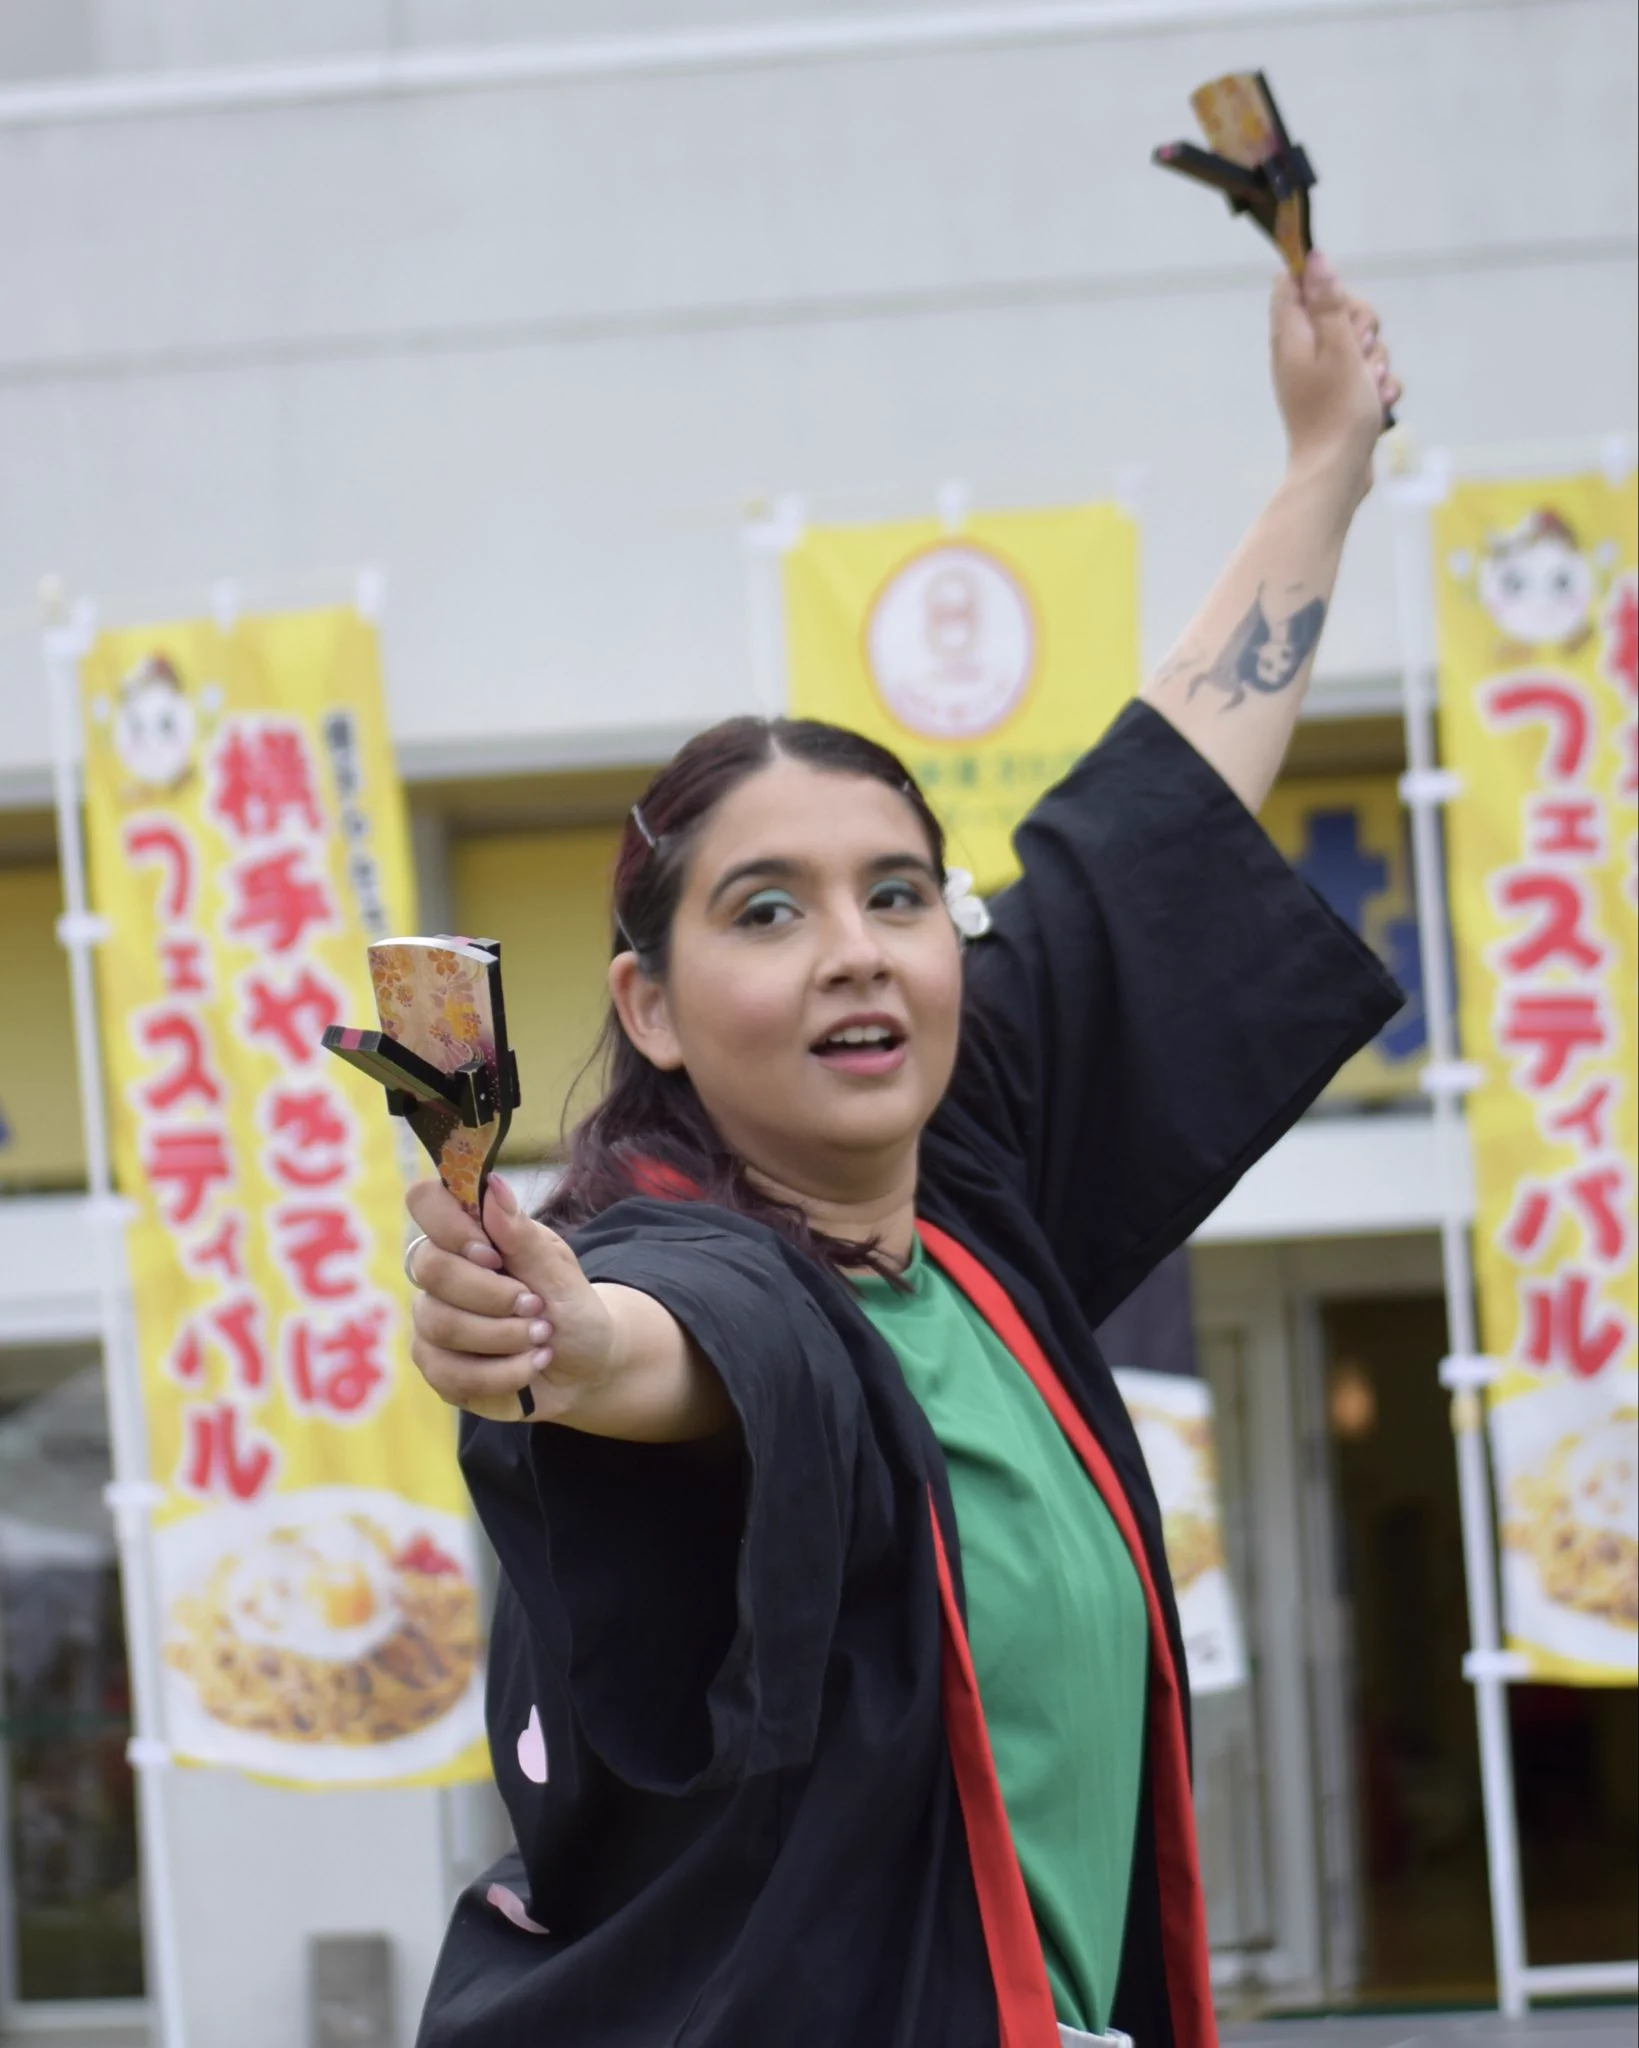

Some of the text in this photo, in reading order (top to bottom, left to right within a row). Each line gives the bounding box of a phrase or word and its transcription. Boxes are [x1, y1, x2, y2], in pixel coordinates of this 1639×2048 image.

[126, 824, 272, 1501] フェスティバル
[211, 724, 383, 1411] 横手やきそば
[1489, 685, 1626, 1379] フェスティバル
